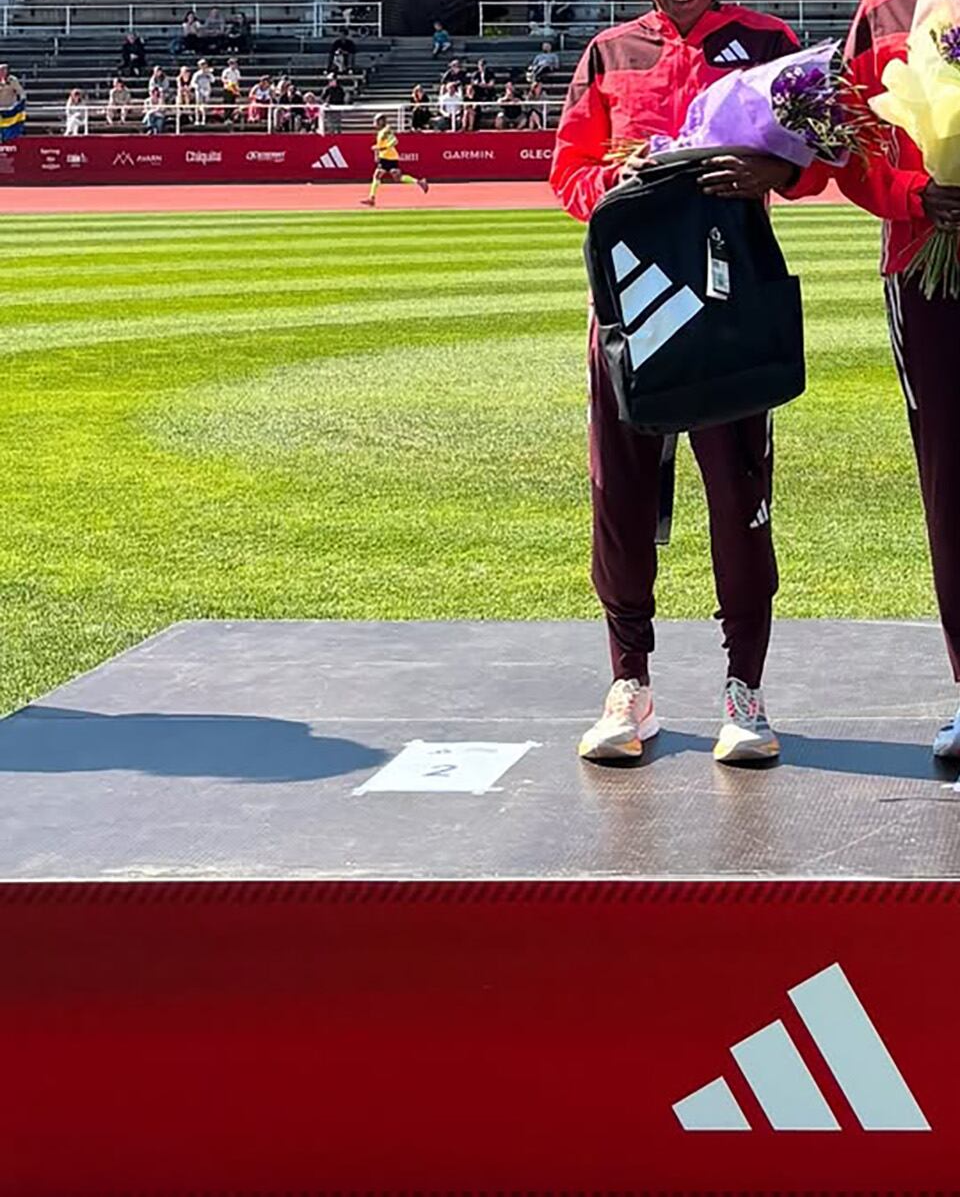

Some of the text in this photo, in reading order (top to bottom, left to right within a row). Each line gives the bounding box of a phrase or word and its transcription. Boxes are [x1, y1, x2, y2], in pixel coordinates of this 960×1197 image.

[443, 150, 495, 160] GARMIN
[520, 149, 553, 159] GLEC
[423, 764, 458, 777] 2
